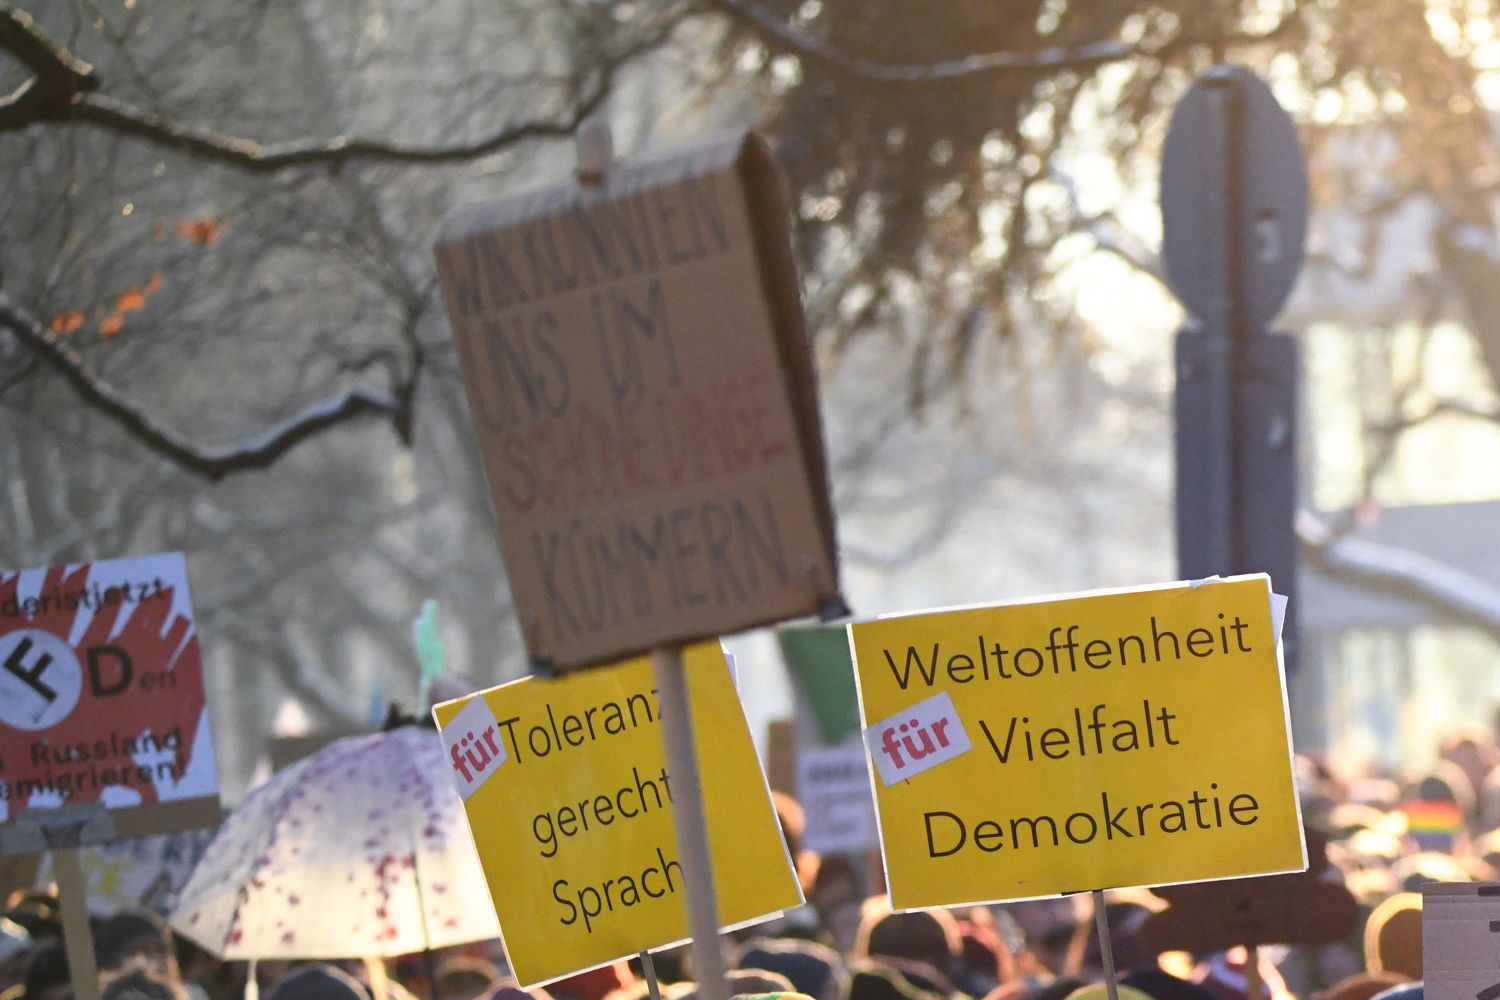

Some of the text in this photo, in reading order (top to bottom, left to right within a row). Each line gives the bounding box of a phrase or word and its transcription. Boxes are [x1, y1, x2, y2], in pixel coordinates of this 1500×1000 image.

[456, 311, 571, 432] UNS
[883, 613, 1251, 689] Weltoffenheit
[31, 724, 181, 768] Russland
[450, 725, 500, 784] für
[882, 718, 949, 769] für
[979, 700, 1179, 763] Vielfalt
[533, 768, 675, 857] gerecht
[924, 783, 1258, 857] Demokratie
